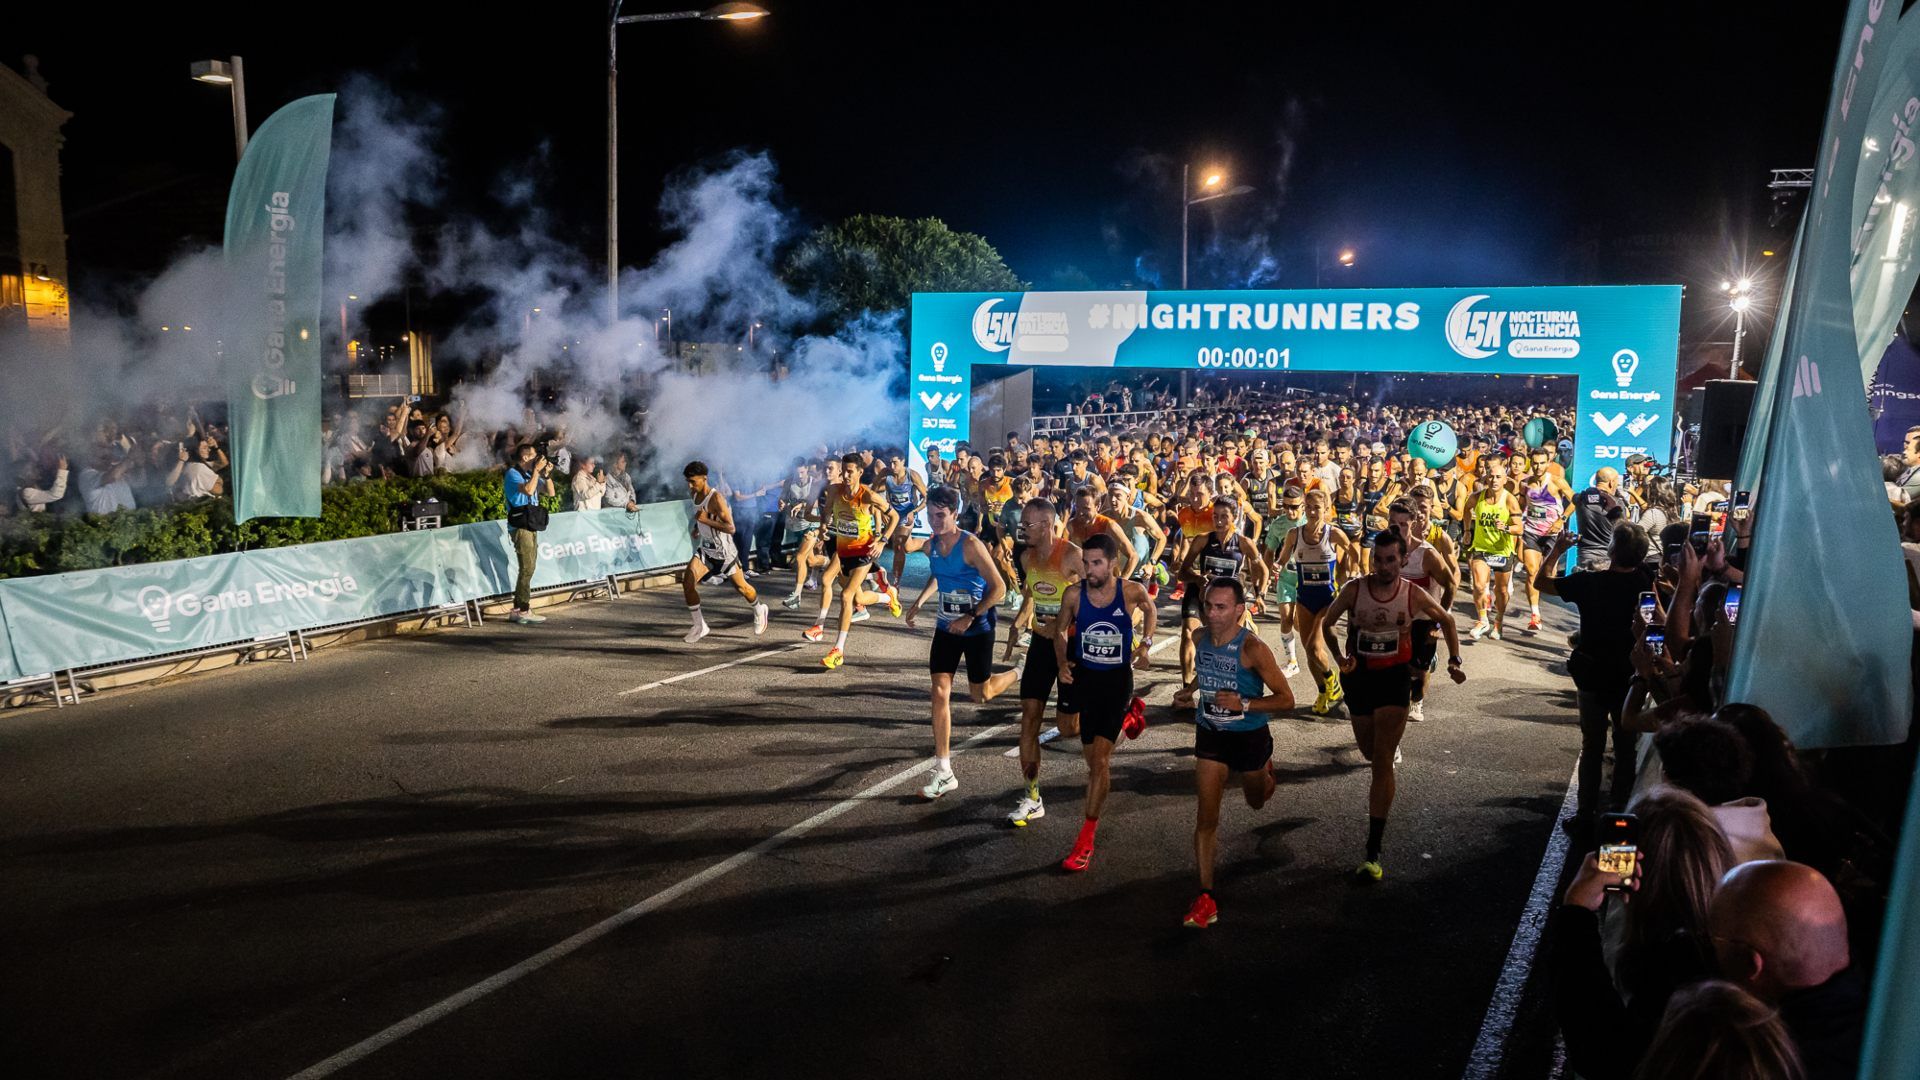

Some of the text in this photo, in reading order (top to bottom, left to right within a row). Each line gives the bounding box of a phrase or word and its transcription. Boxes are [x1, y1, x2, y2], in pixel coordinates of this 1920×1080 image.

[265, 191, 295, 295] Energía
[1088, 302, 1421, 331] #NIGHTRUNNERS
[1509, 310, 1579, 322] NOCTURNA
[1458, 311, 1507, 348] 15K
[1509, 323, 1580, 338] VALENCIA
[1198, 347, 1290, 369] 00:00:01
[1590, 389, 1661, 403] Gana Energía
[538, 540, 586, 560] Gana
[176, 571, 358, 617] Gana Energía
[1088, 645, 1116, 655] 8767
